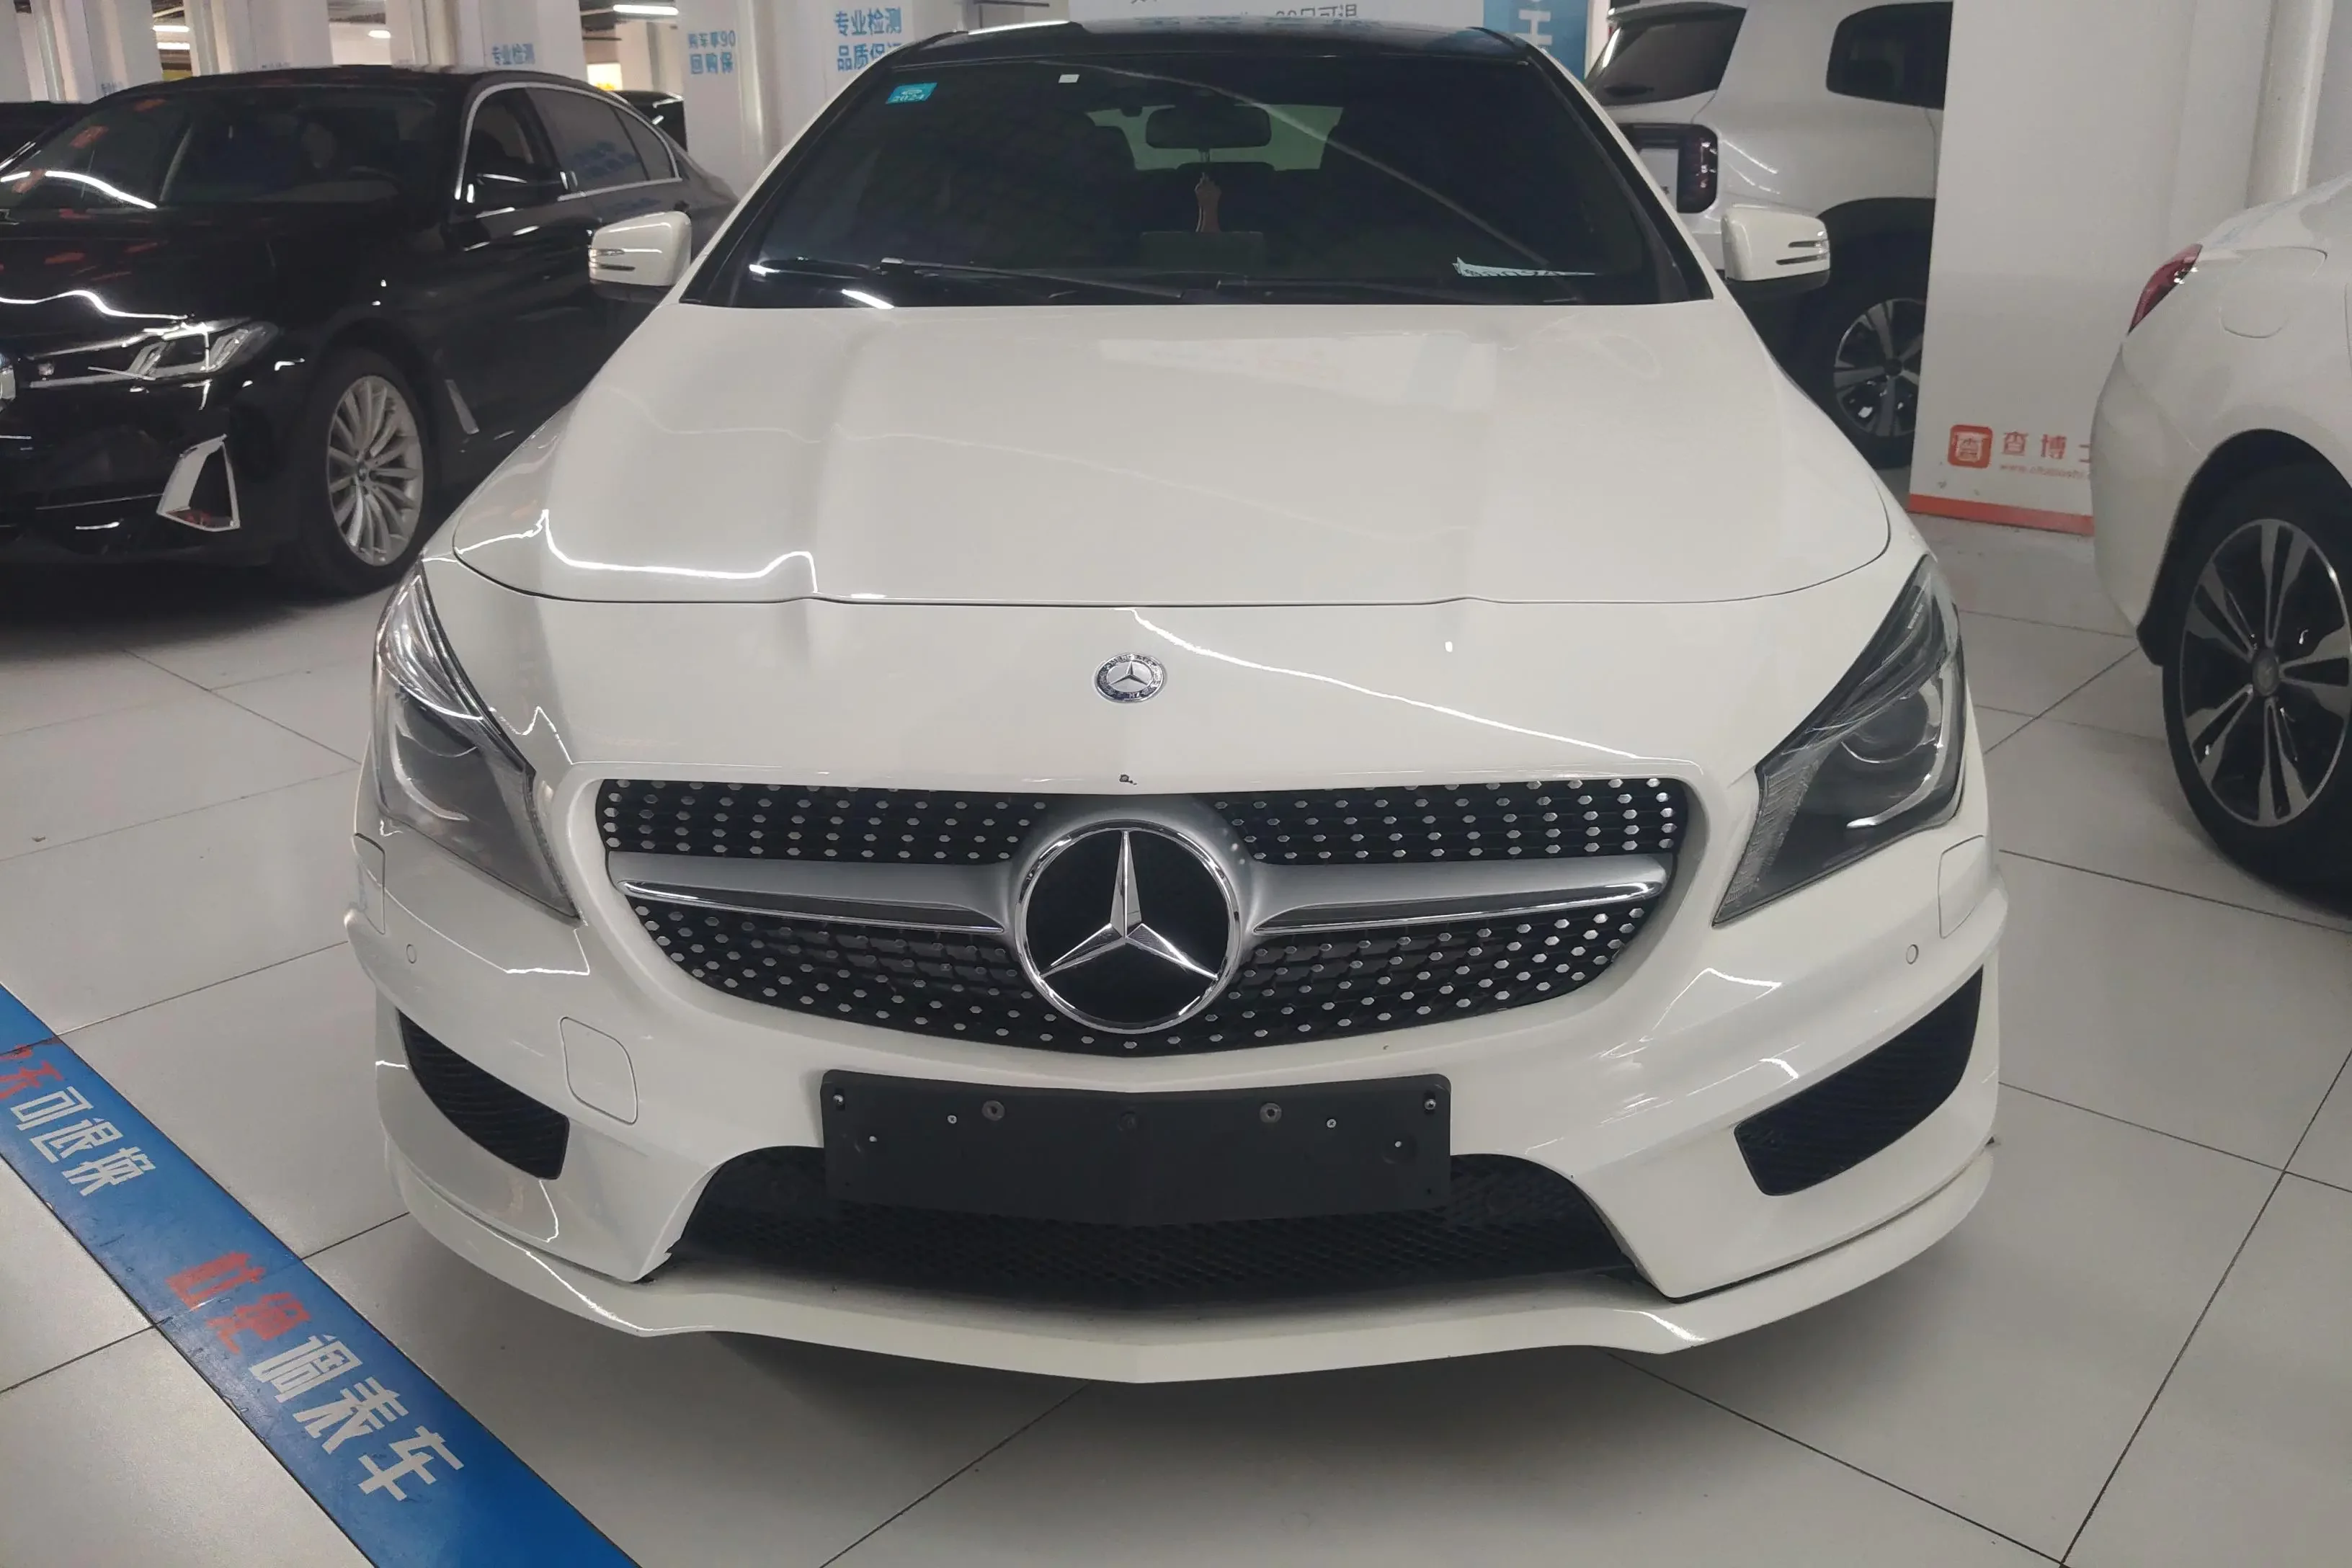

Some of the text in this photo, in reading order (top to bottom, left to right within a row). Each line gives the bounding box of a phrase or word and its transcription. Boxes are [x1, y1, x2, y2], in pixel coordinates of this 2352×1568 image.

[834, 6, 902, 37] 专业检测
[837, 43, 902, 71] 品质保
